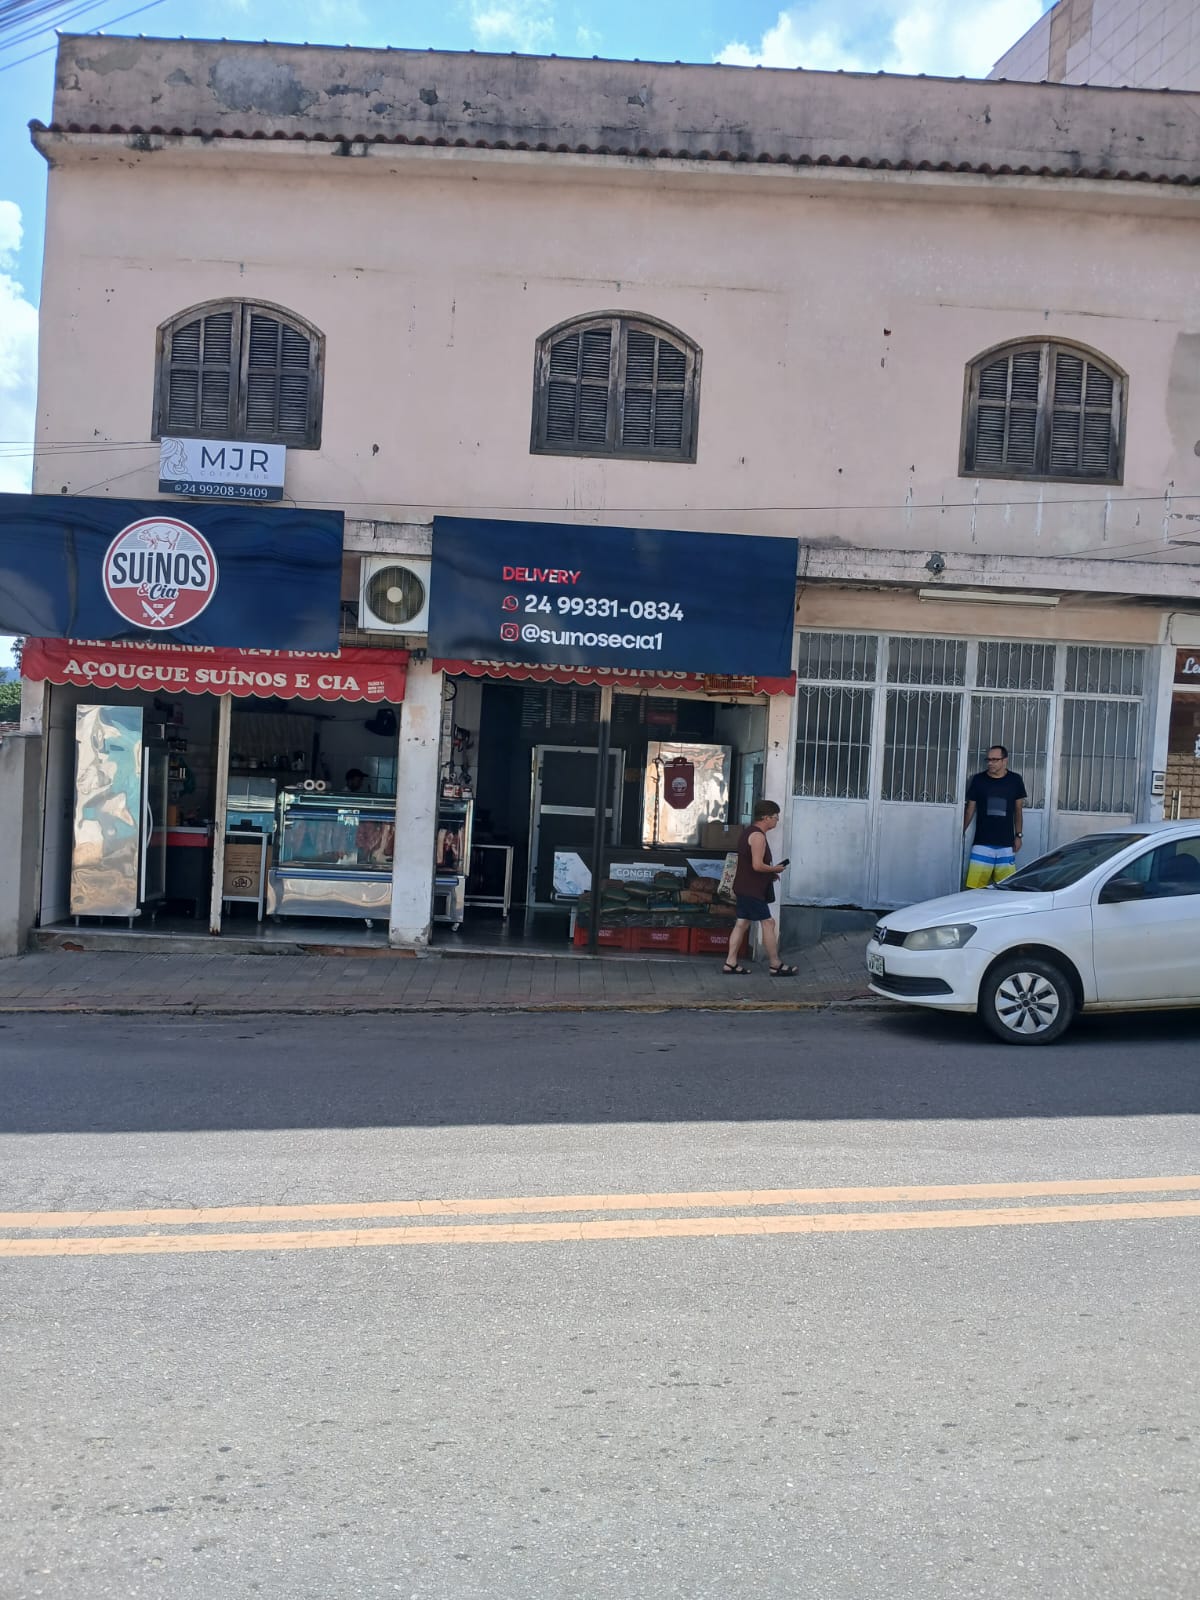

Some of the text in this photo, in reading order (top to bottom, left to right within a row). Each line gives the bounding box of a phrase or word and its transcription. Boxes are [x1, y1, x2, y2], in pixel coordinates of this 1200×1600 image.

[201, 446, 269, 473] MJR
[182, 484, 268, 498] 24 99208-9409
[502, 566, 581, 584] DELIVERY
[139, 582, 179, 599] & Cia
[525, 594, 684, 621] 24 99331-0834
[62, 659, 190, 682] AÇOUGUE
[195, 666, 287, 688] SUÍNOS
[295, 673, 311, 689] E
[317, 675, 361, 691] CIA
